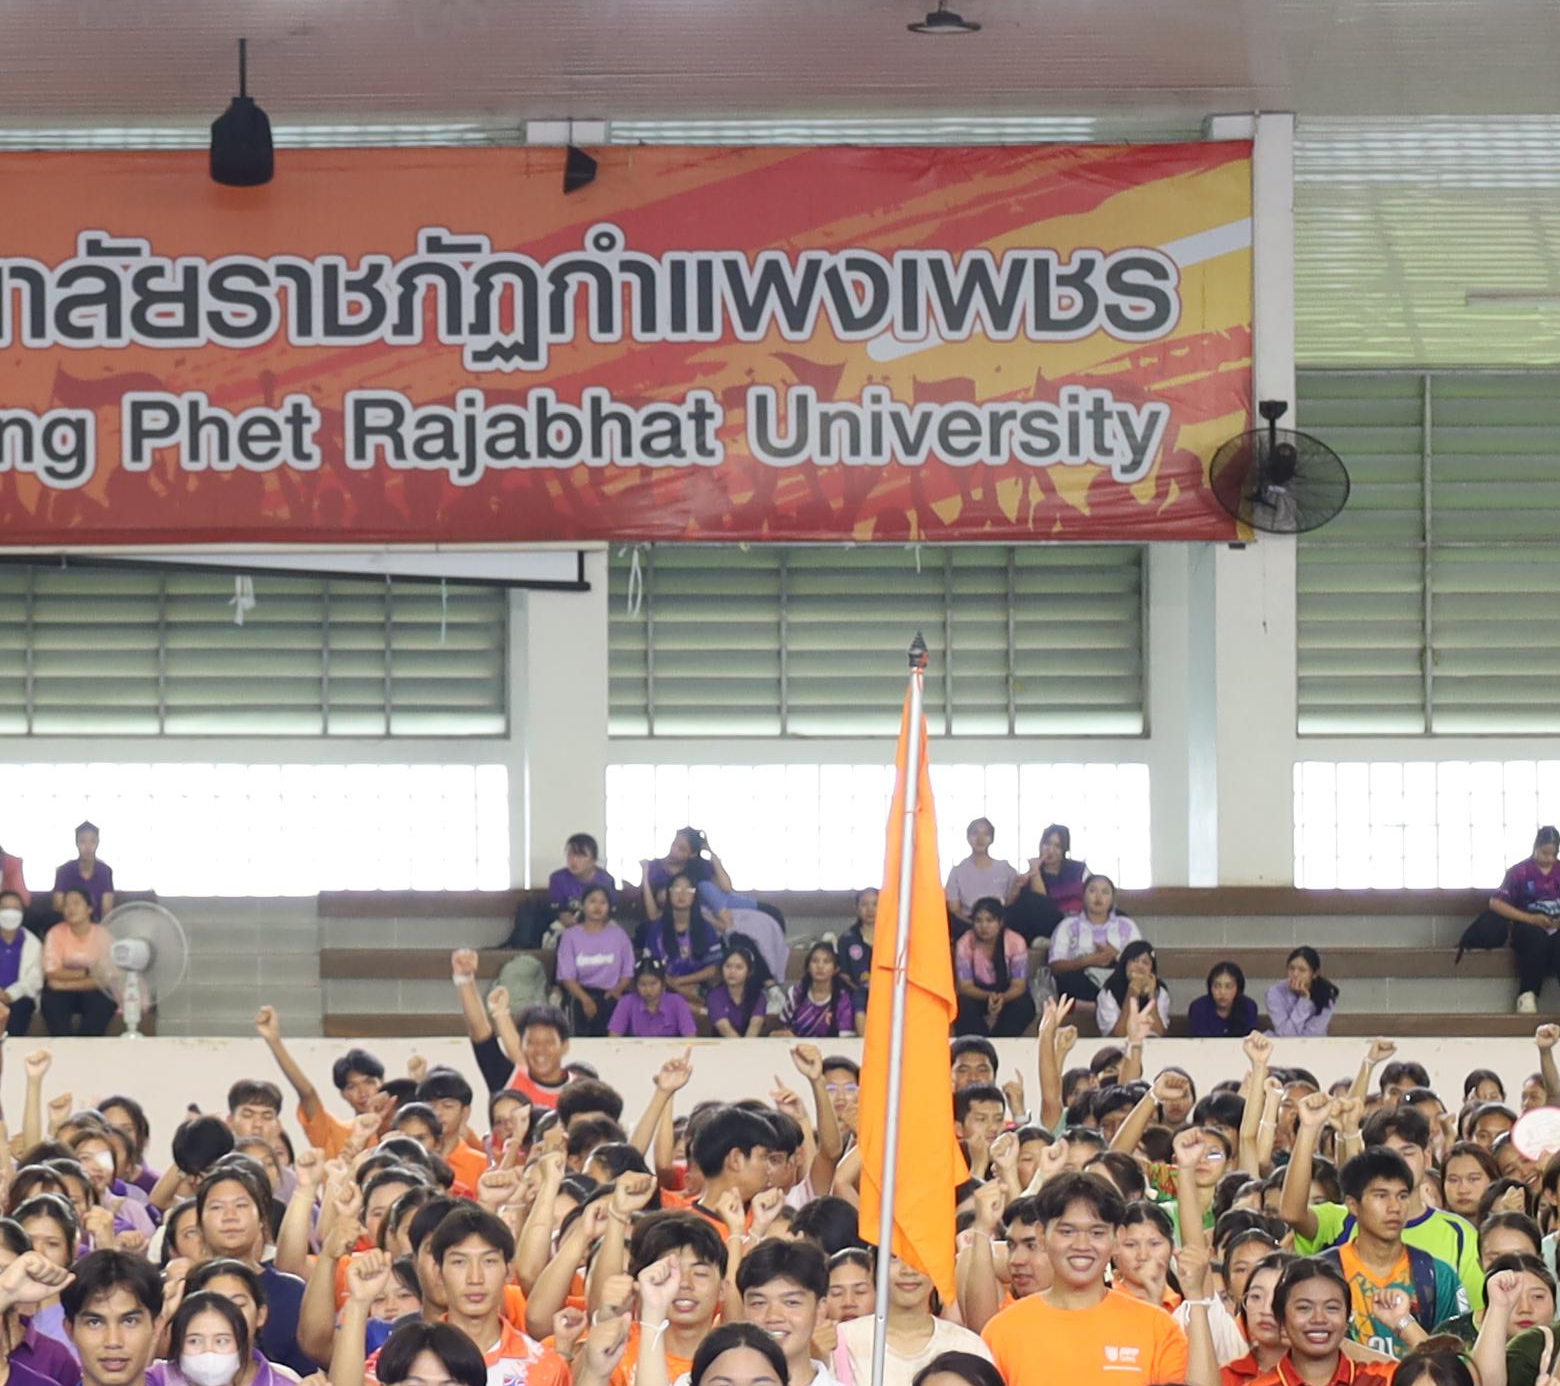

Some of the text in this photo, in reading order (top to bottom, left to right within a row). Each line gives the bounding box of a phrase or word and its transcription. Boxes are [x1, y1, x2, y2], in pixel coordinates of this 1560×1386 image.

[128, 398, 313, 464] Phet
[351, 394, 722, 479] Rajabhat
[753, 393, 1163, 474] University
